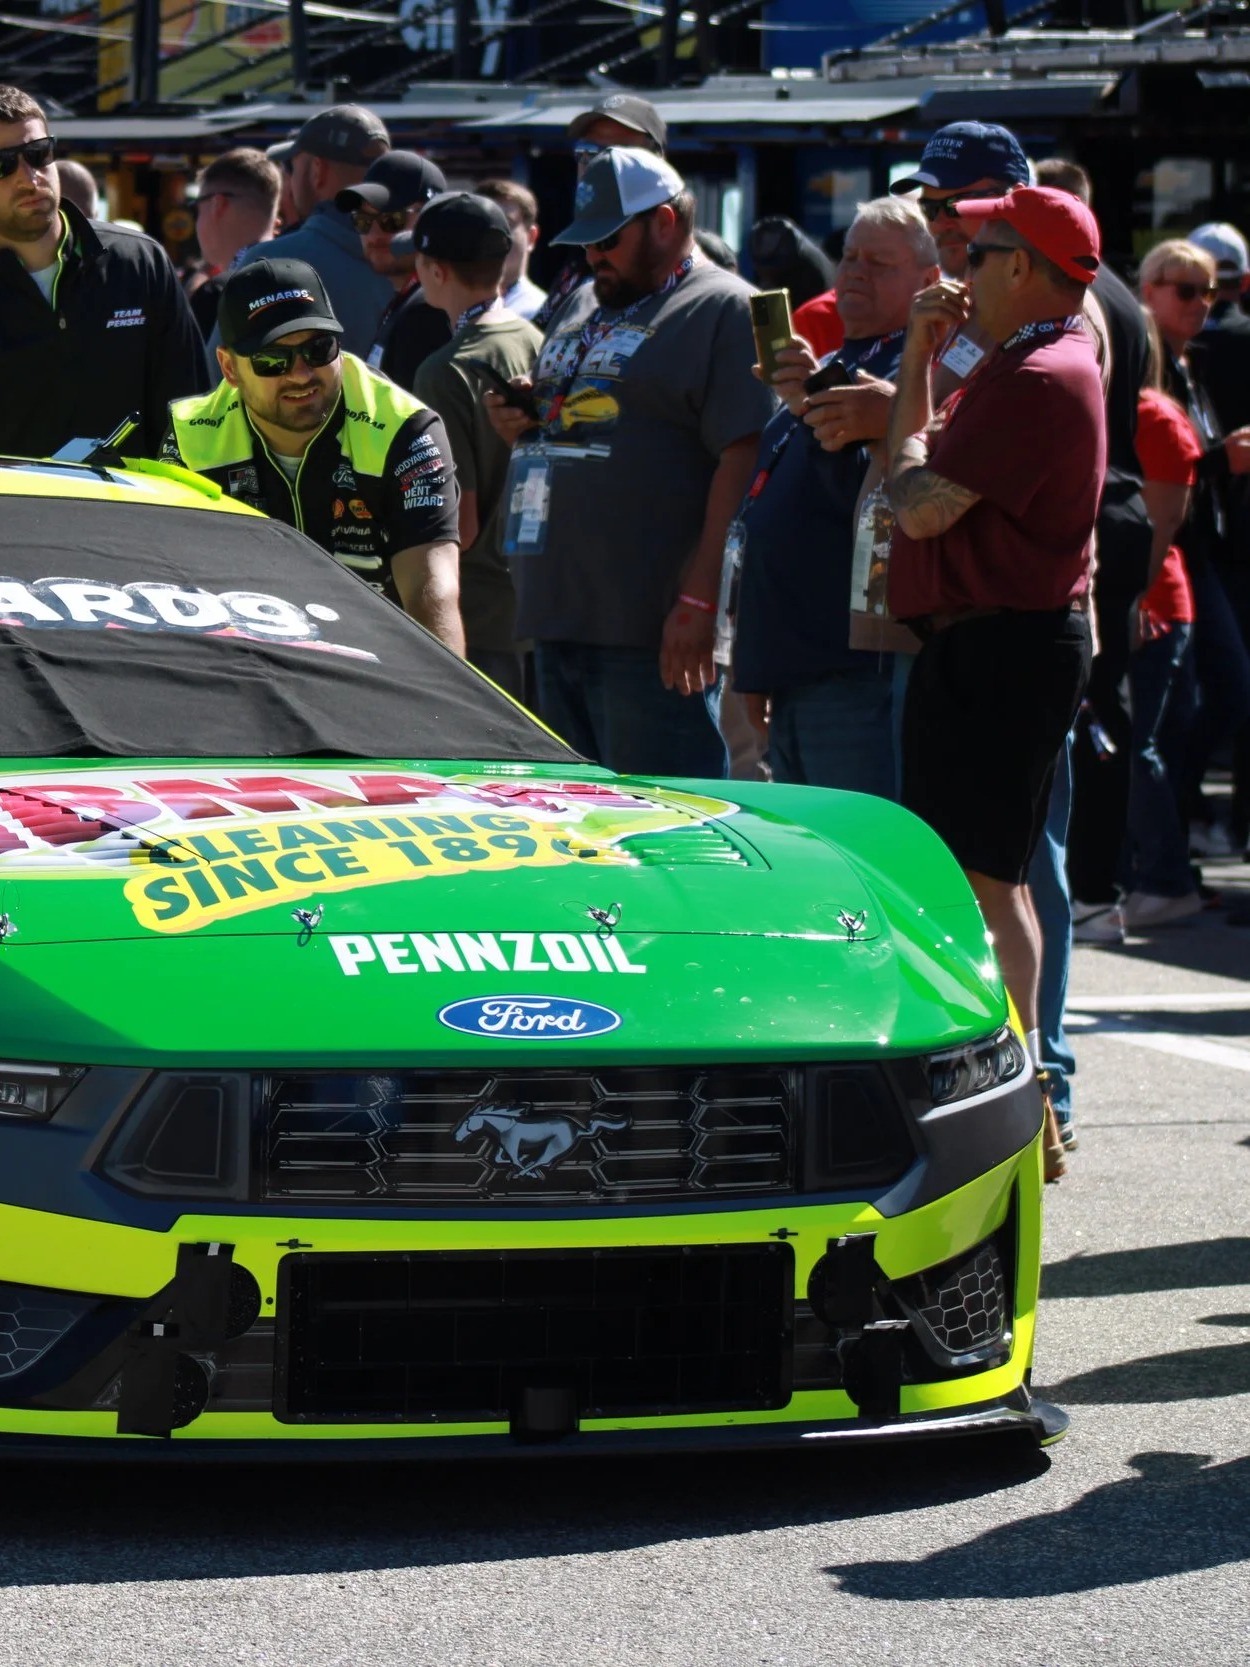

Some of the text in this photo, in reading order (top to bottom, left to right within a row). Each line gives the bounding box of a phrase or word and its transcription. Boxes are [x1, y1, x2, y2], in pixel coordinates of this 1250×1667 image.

[249, 289, 310, 311] MENARDS
[106, 317, 146, 329] PENSKE
[113, 308, 143, 318] TEAM
[404, 485, 431, 499] DENT
[403, 496, 444, 511] WIZARD
[153, 812, 533, 870] CLEANING
[142, 845, 371, 922] SINCE
[328, 932, 648, 976] PENNZOIL
[478, 1001, 587, 1032] Ford
